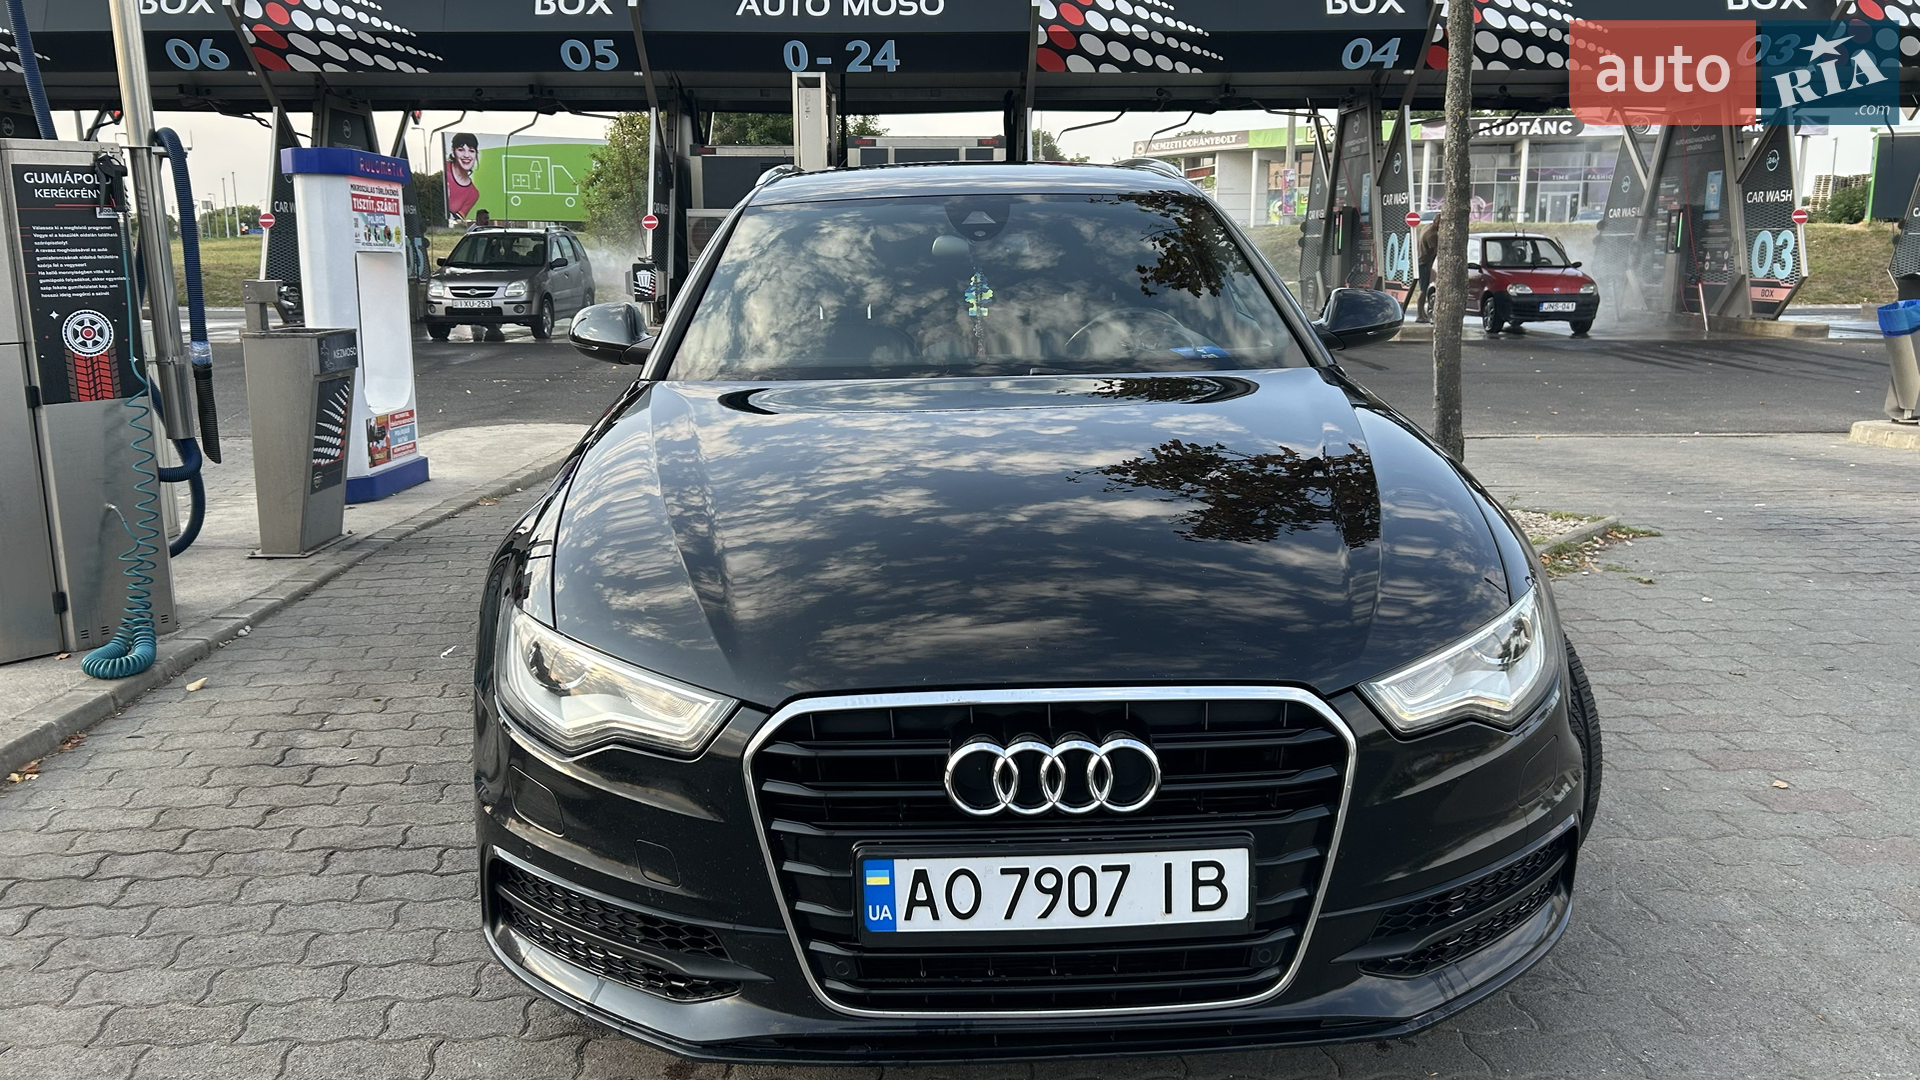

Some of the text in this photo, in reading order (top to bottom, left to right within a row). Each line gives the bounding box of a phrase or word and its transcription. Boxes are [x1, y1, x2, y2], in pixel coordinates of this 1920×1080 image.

[165, 38, 230, 71] 06
[560, 39, 619, 71] 05
[783, 39, 809, 72] 0
[845, 39, 900, 73] 24
[1341, 37, 1401, 70] 04
[1478, 117, 1573, 136] RÚDTÁNC
[1151, 134, 1238, 151] NEMZETI DOHÁNYBOLT
[23, 171, 112, 185] GUMIÁPOL
[1746, 189, 1792, 203] CAR WASH
[274, 201, 289, 213] CAR
[1608, 208, 1621, 218] CAR
[1386, 232, 1411, 282] 04
[1752, 229, 1795, 279] 03
[1760, 288, 1774, 298] BOX
[903, 859, 1229, 922] AO 7907 IB
[868, 904, 893, 921] UA
